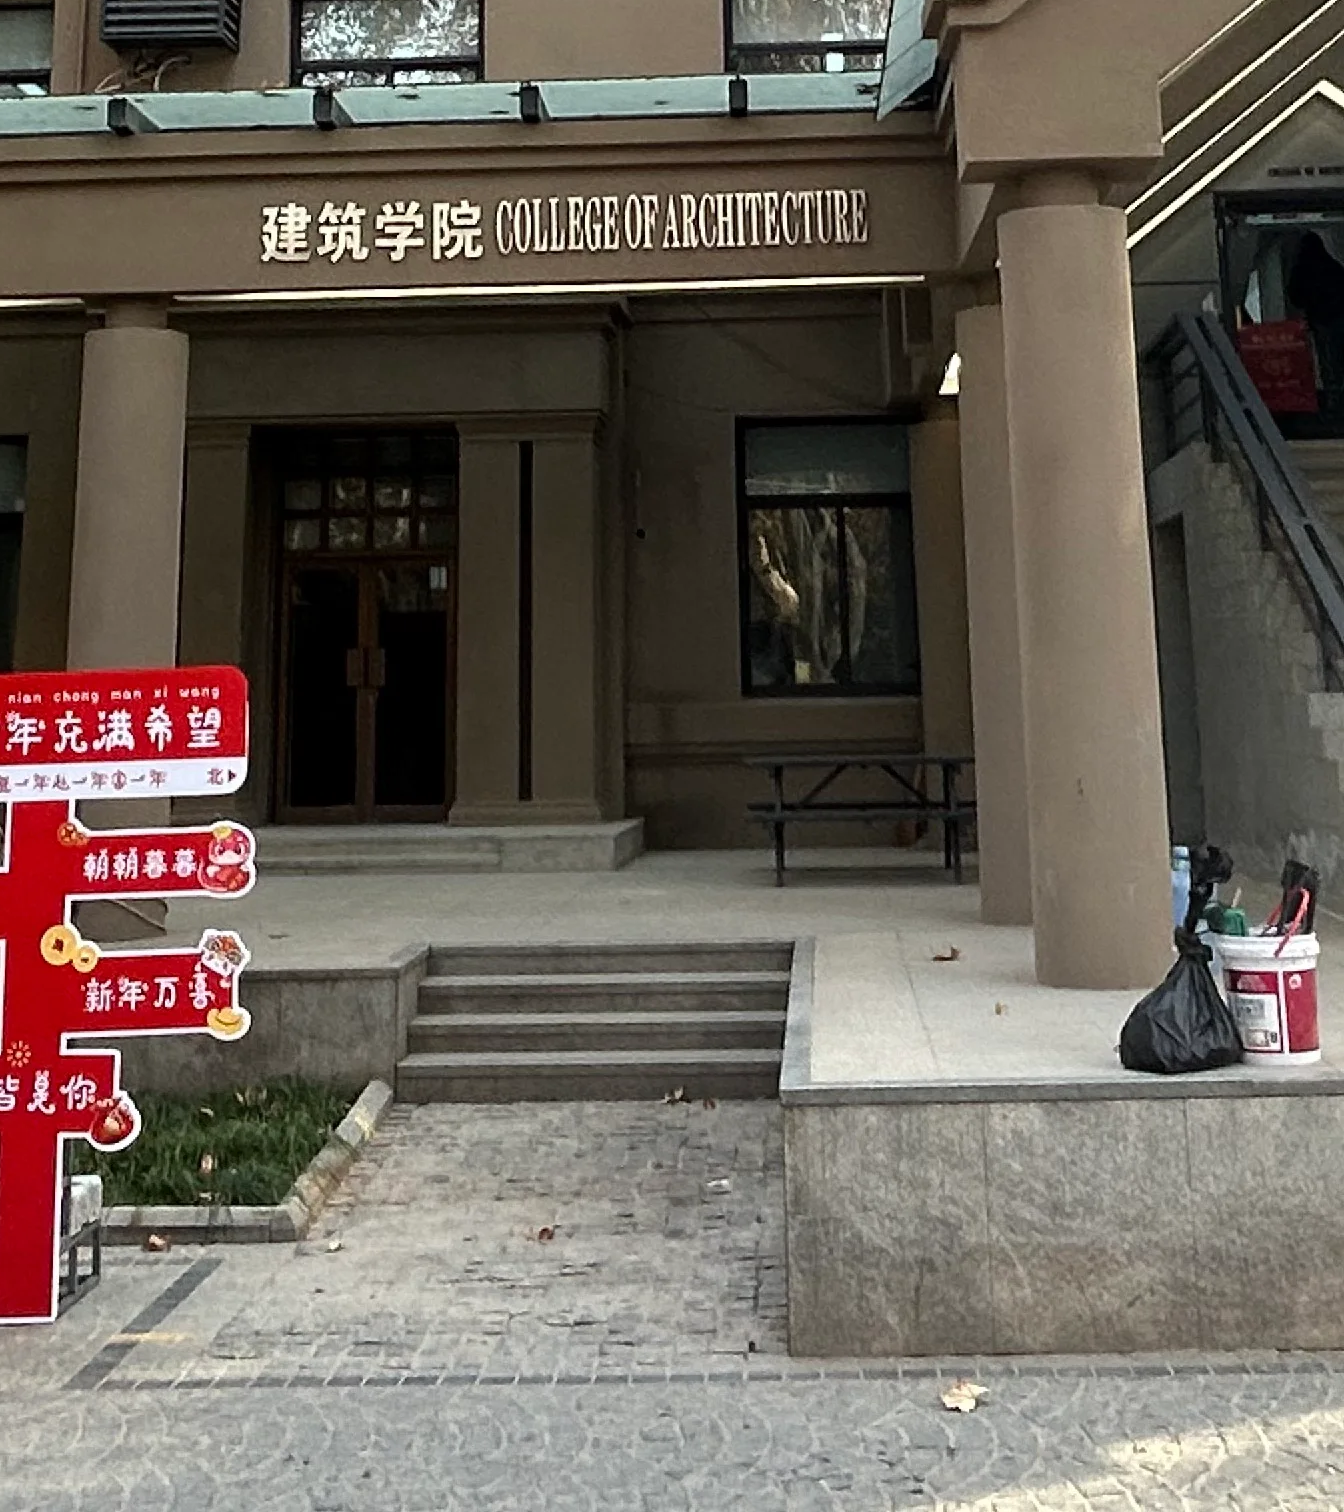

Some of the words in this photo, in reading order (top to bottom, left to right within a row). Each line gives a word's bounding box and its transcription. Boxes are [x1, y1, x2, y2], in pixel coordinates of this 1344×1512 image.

[260, 200, 484, 263] 建筑学院
[494, 195, 620, 255] COLLEGE
[623, 194, 660, 250] OF
[662, 188, 870, 249] ARCHITECTURE
[7, 691, 43, 705] nian
[53, 689, 100, 704] chong
[83, 846, 197, 882] 朝朝暮暮
